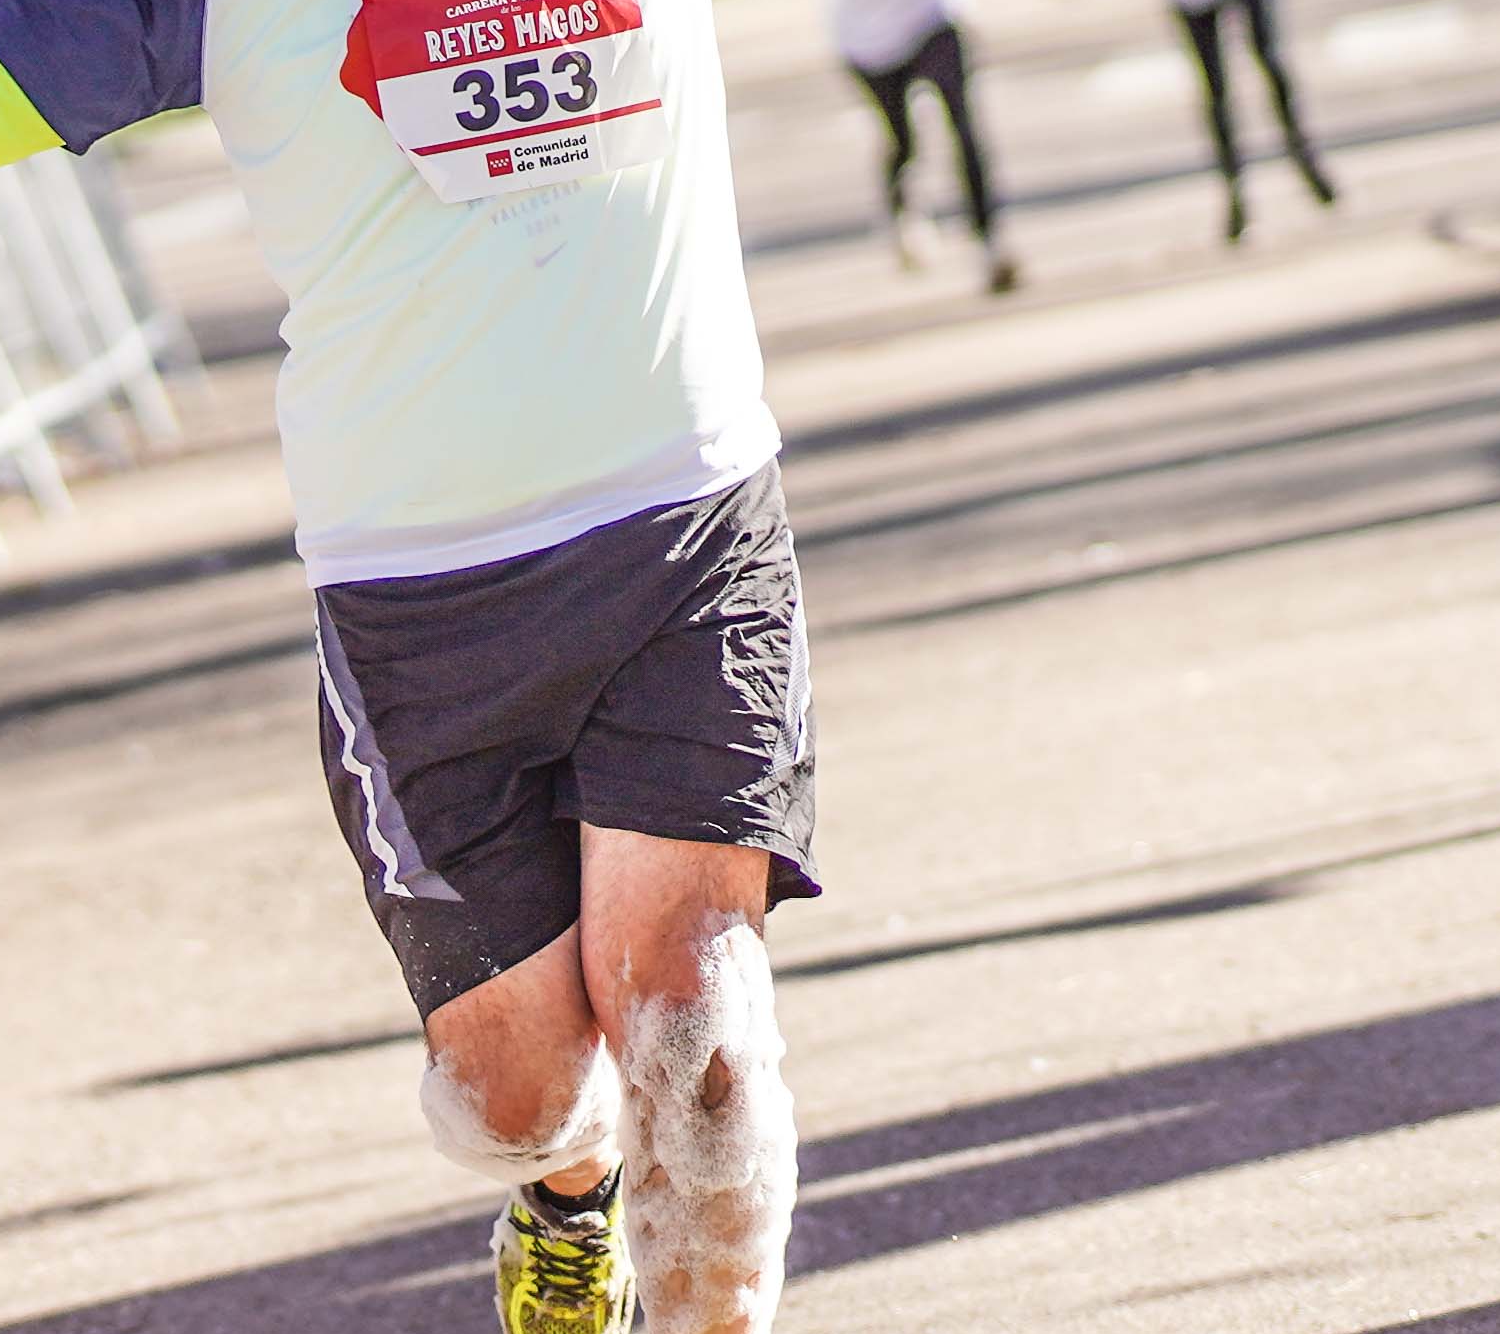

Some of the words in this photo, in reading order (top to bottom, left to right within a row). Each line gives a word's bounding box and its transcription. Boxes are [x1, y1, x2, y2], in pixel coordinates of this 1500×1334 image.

[423, 19, 506, 63] REYES
[513, 0, 600, 48] MAGOS
[452, 50, 599, 132] 353
[514, 134, 588, 158] Comunidad
[516, 160, 535, 173] de
[539, 148, 590, 169] Madrid
